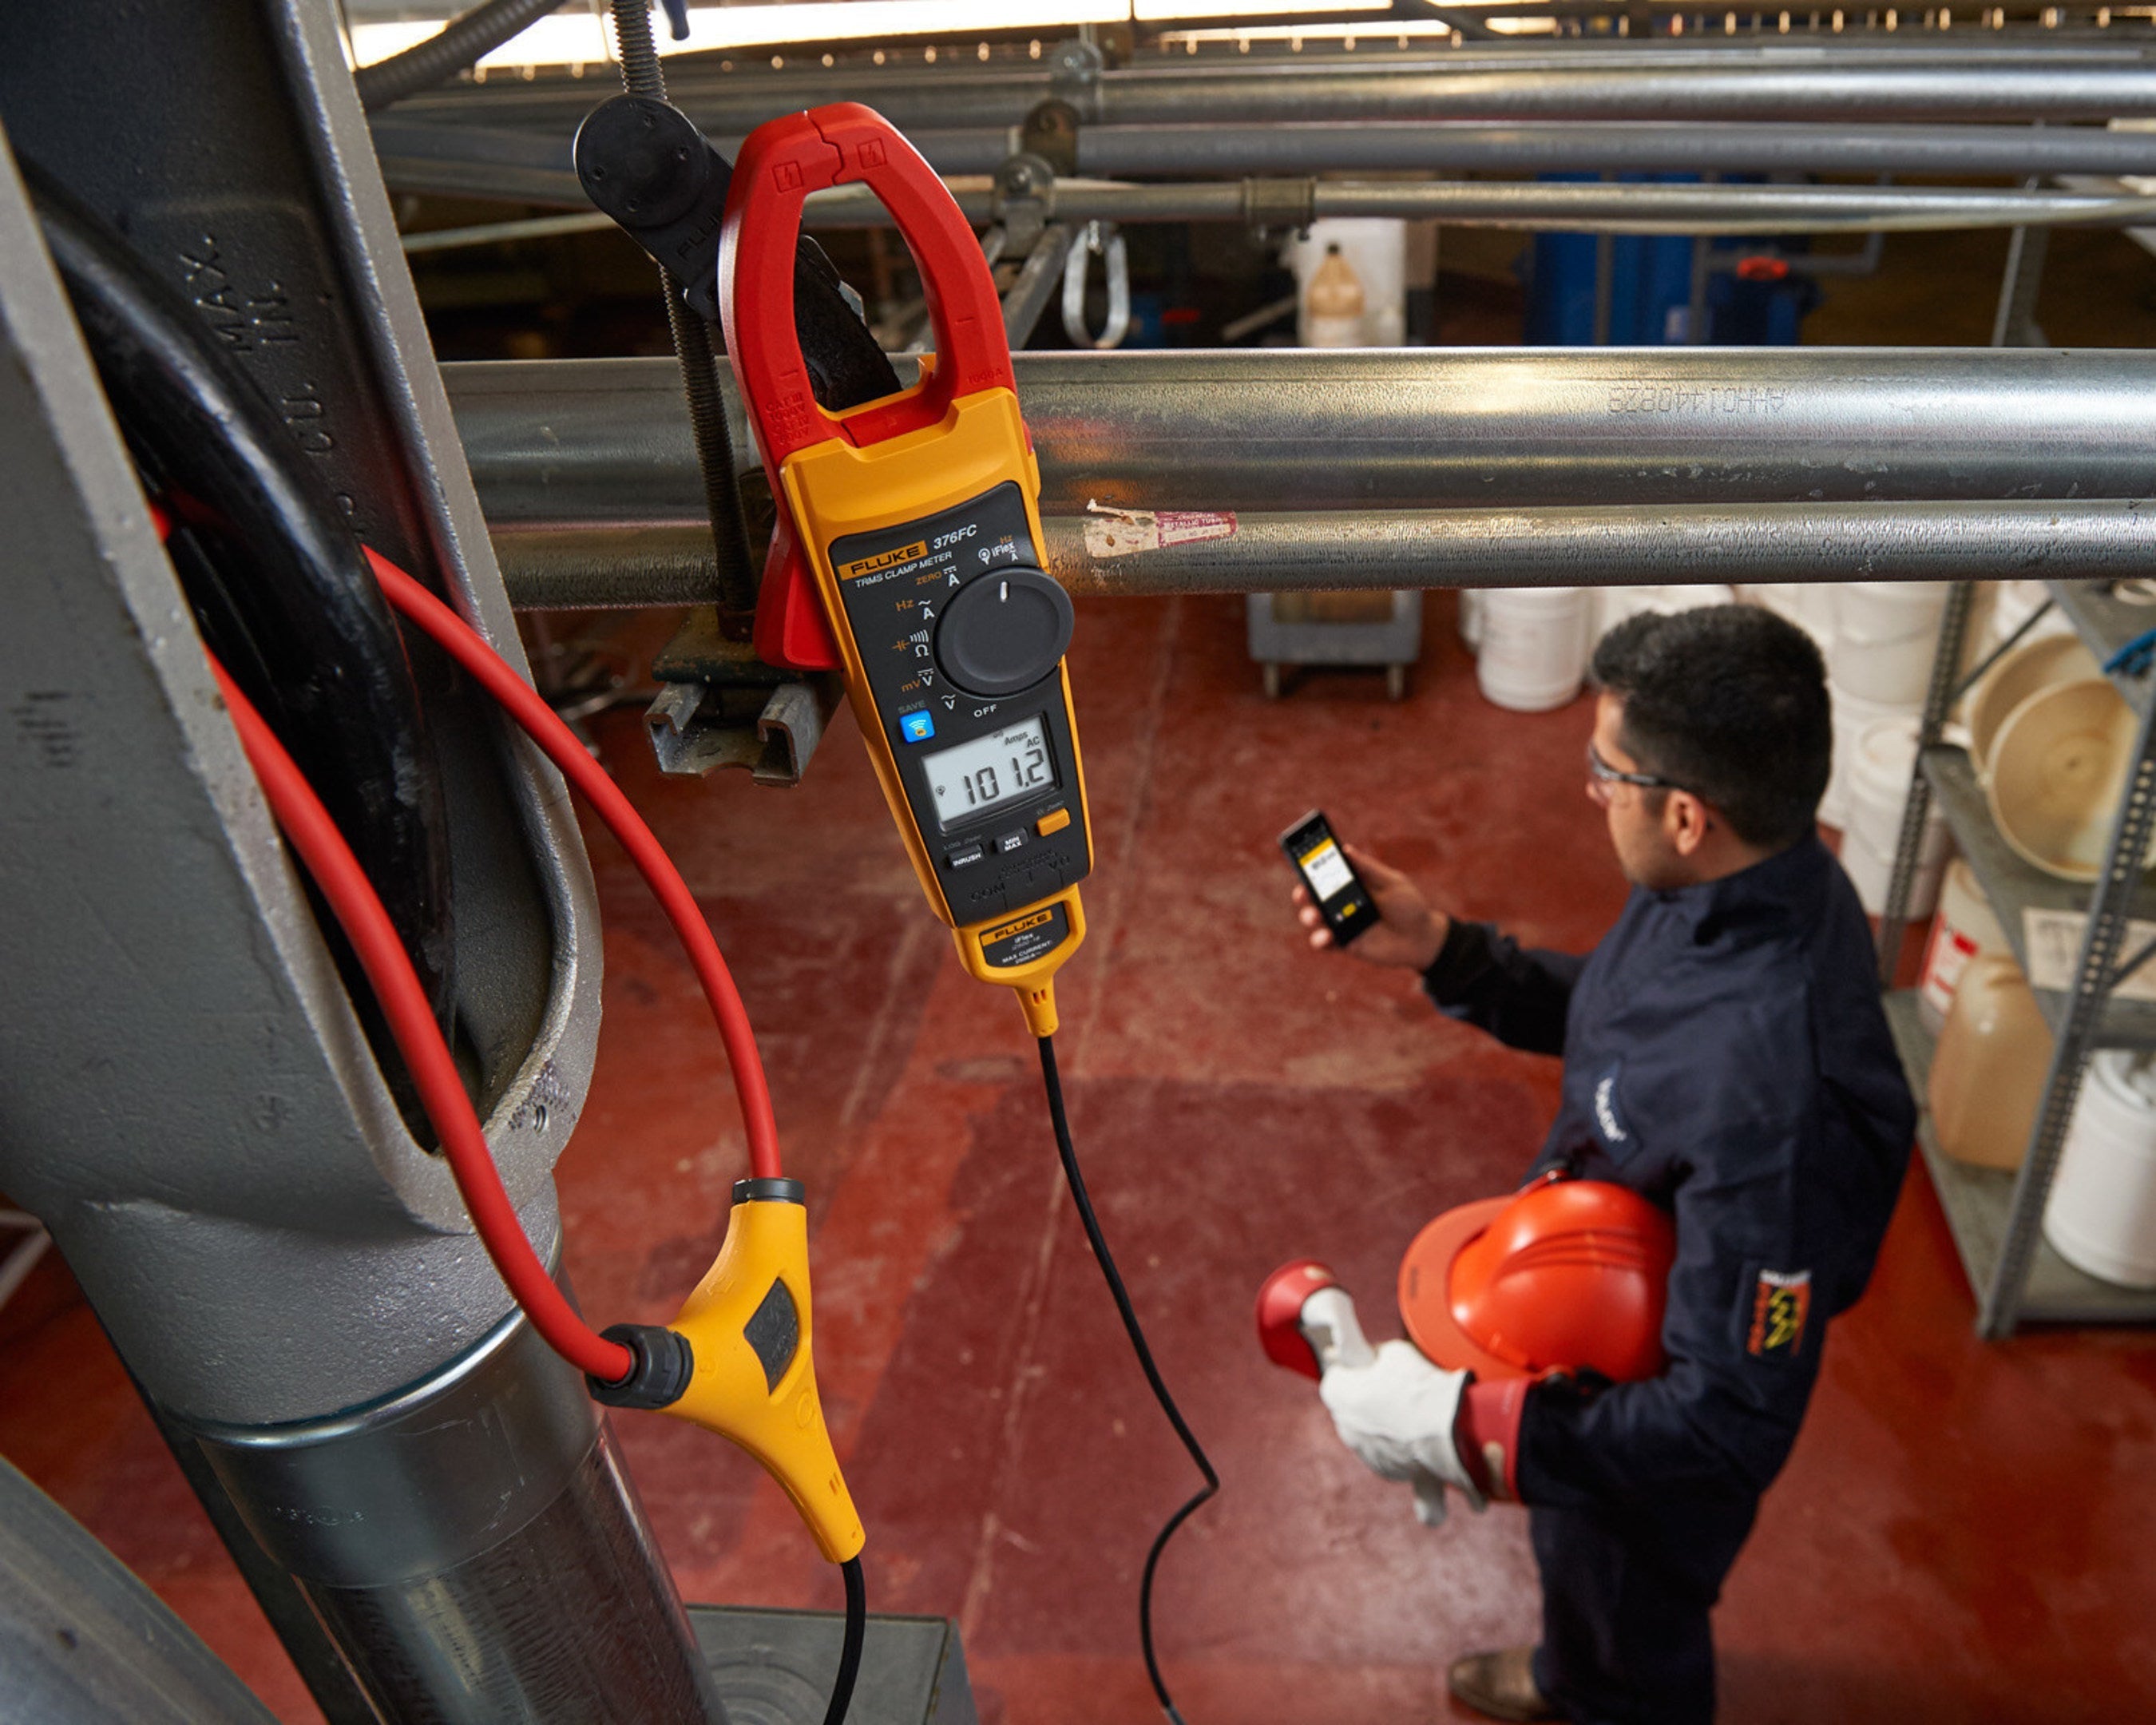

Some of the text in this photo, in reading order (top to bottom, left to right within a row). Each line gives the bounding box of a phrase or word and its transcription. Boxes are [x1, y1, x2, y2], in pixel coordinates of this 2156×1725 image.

[933, 524, 977, 550] 376FC
[1000, 535, 1013, 544] Hz
[850, 545, 921, 575] FLUKE
[855, 550, 953, 589] TRMS CLAMP METER
[916, 570, 961, 587] ZERO A
[895, 599, 935, 621] Hz A
[901, 675, 933, 694] mV V
[898, 699, 926, 715] SAVE
[945, 699, 956, 711] V
[973, 704, 998, 719] OFF
[1004, 731, 1028, 748] Amps
[1027, 736, 1040, 747] AC
[963, 748, 1045, 807] 101.2
[1004, 841, 1023, 852] MAX
[1005, 835, 1021, 846] MIN
[952, 852, 982, 867] INRUSH
[994, 914, 1048, 939] FLUKE
